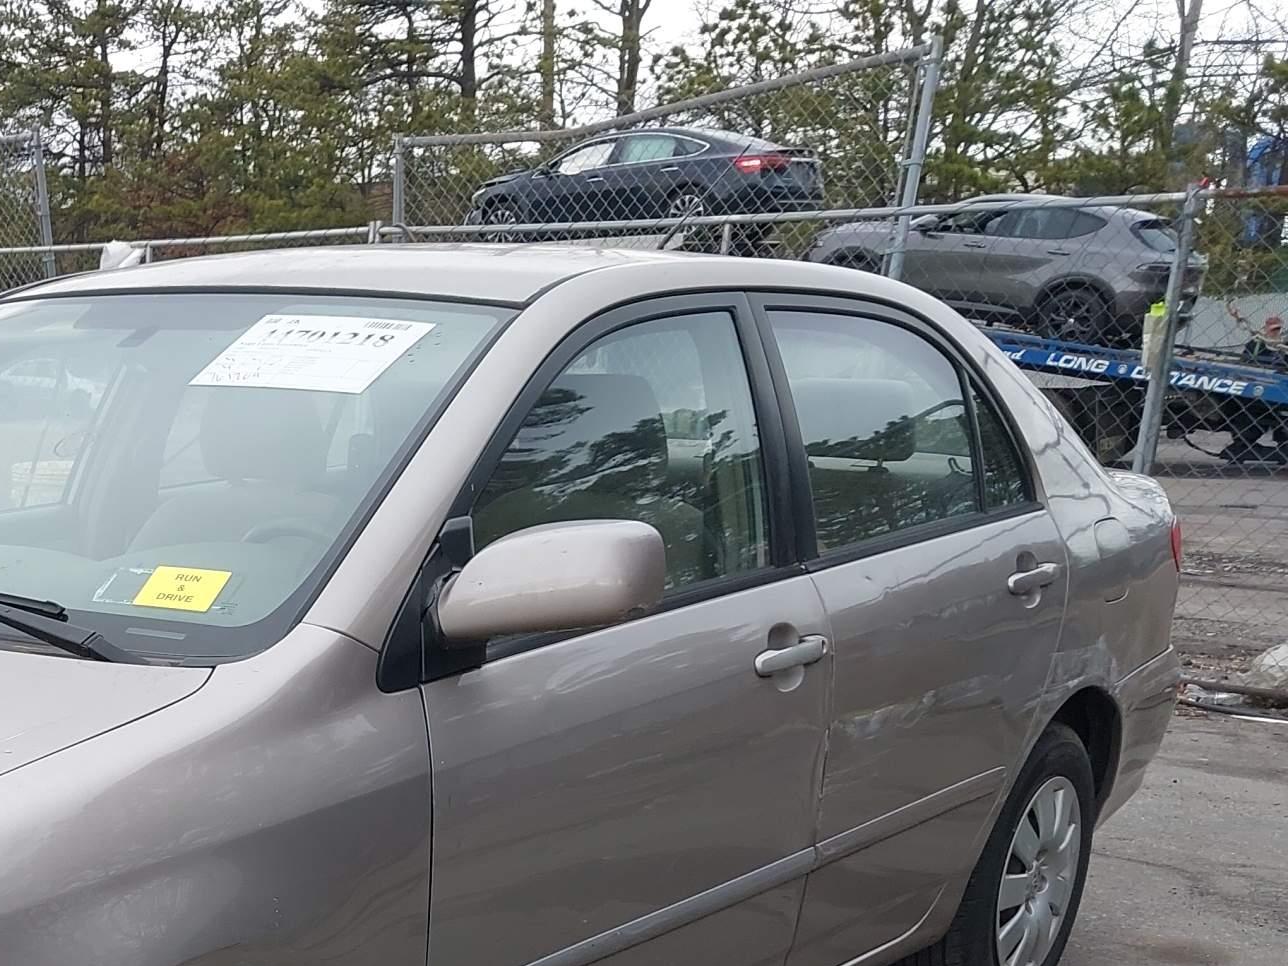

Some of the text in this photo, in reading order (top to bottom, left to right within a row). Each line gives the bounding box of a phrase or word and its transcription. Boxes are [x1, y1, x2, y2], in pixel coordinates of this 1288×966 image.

[1045, 352, 1109, 373] LONG
[1130, 365, 1249, 395] DTANCE
[175, 574, 202, 583] RUN
[177, 584, 185, 592] &
[156, 592, 194, 603] DRIVE
